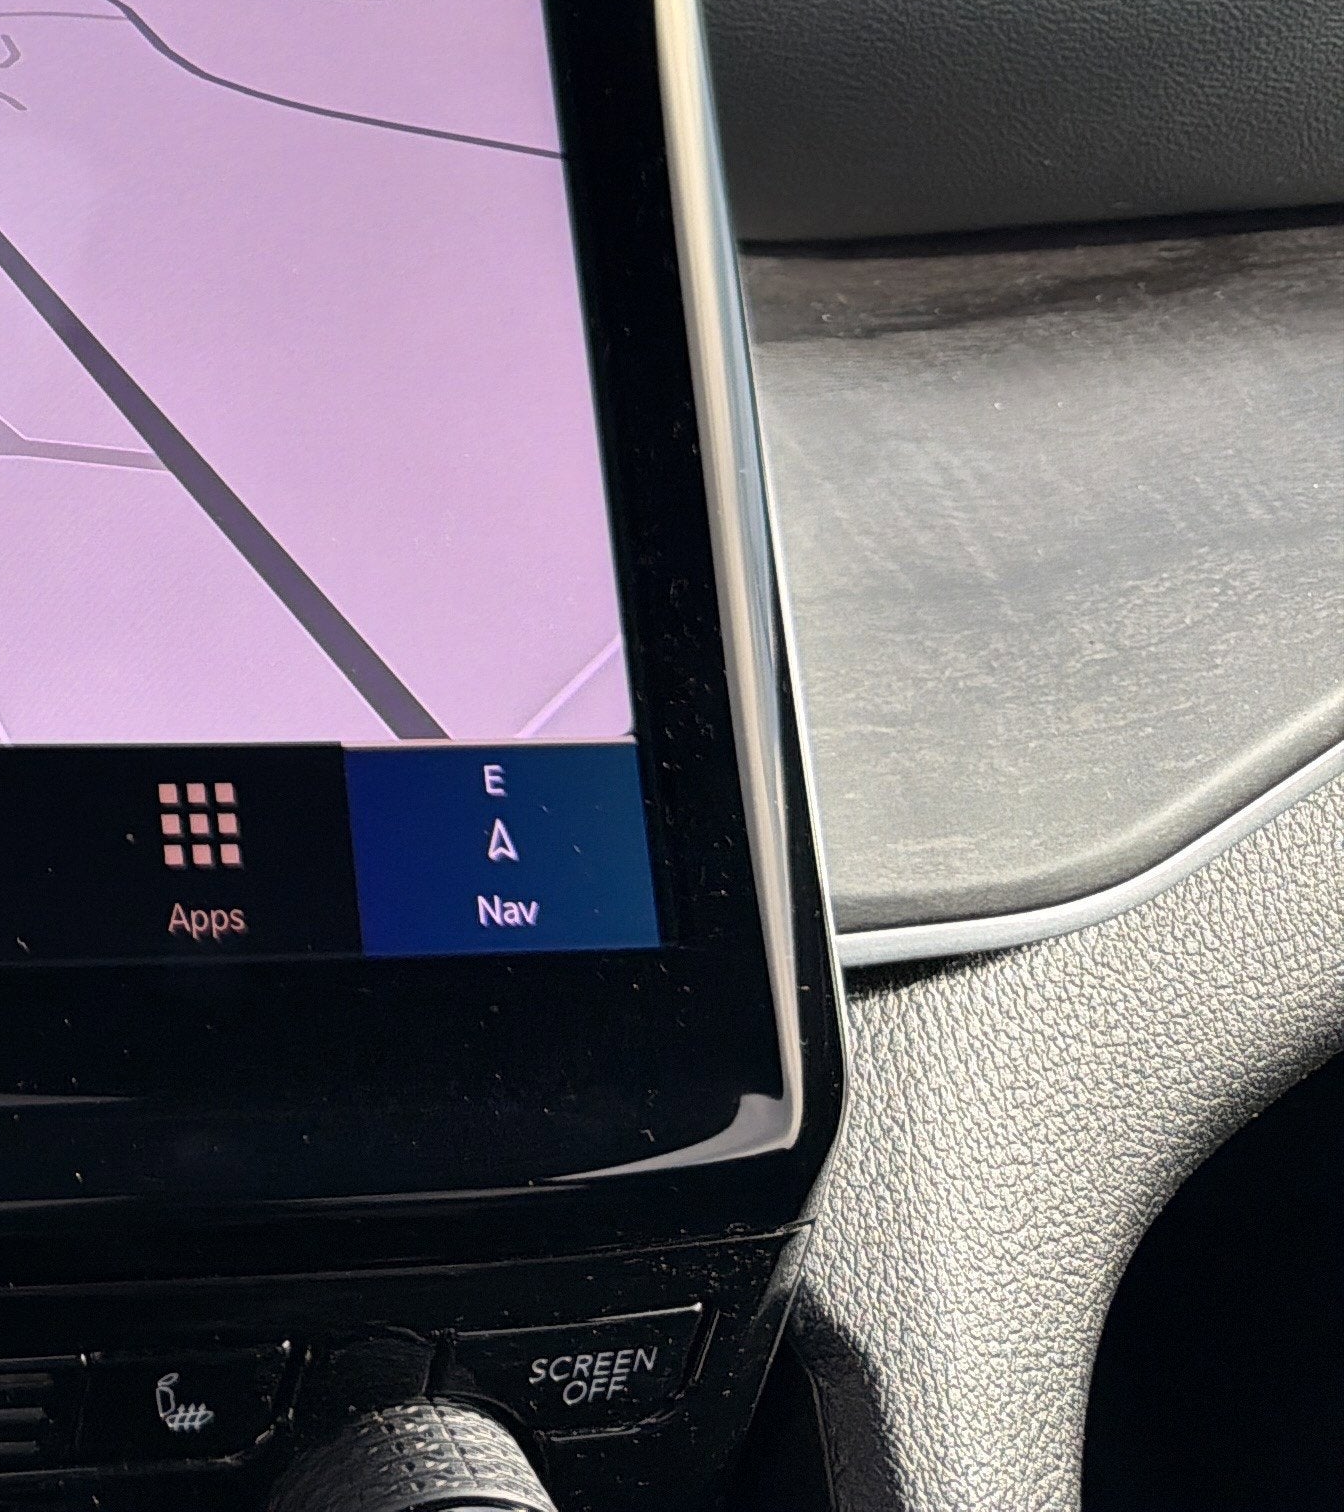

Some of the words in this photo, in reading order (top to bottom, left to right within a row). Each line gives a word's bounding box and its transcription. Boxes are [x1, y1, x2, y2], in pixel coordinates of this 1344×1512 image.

[483, 766, 504, 796] E
[168, 901, 246, 939] Apps
[477, 893, 539, 928] Nav
[528, 1346, 659, 1384] SCREEN
[562, 1375, 628, 1406] OFF
